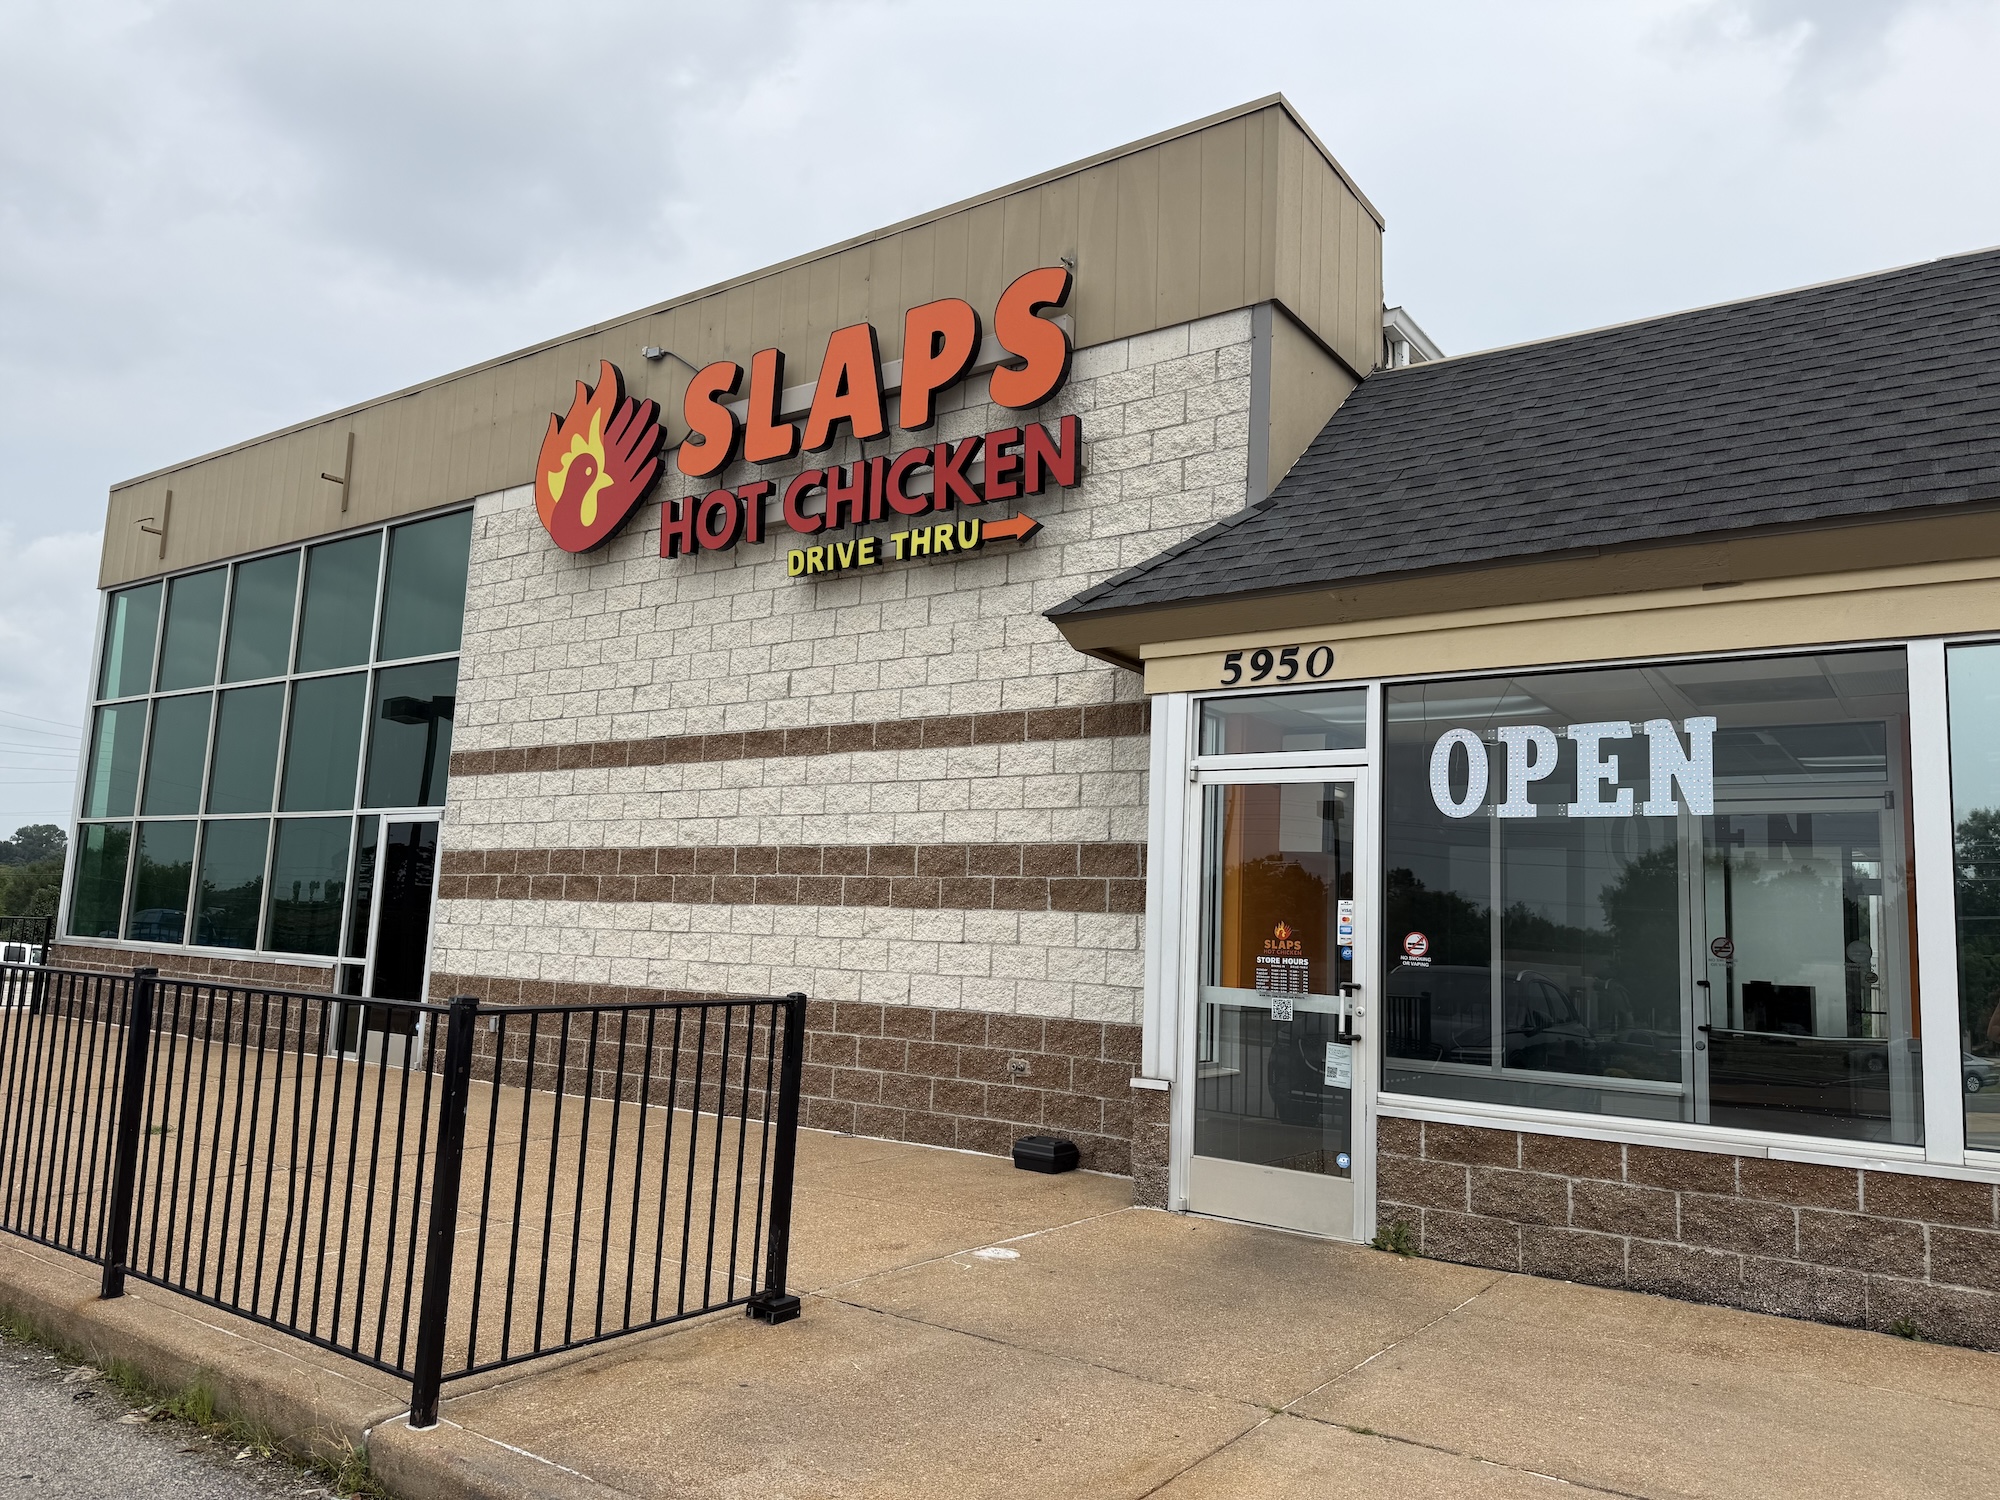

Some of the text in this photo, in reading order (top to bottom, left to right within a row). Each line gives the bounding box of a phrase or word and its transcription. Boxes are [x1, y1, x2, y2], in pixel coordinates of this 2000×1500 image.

[677, 266, 1072, 478] SLAPS
[660, 414, 1081, 559] HOT CHICKEN
[787, 518, 983, 577] DRIVE THRU
[1220, 646, 1334, 685] 5950
[1429, 716, 1717, 818] OPEN
[1256, 956, 1280, 964] STORE
[1282, 957, 1309, 966] HOURS
[1264, 939, 1301, 950] SLAPS
